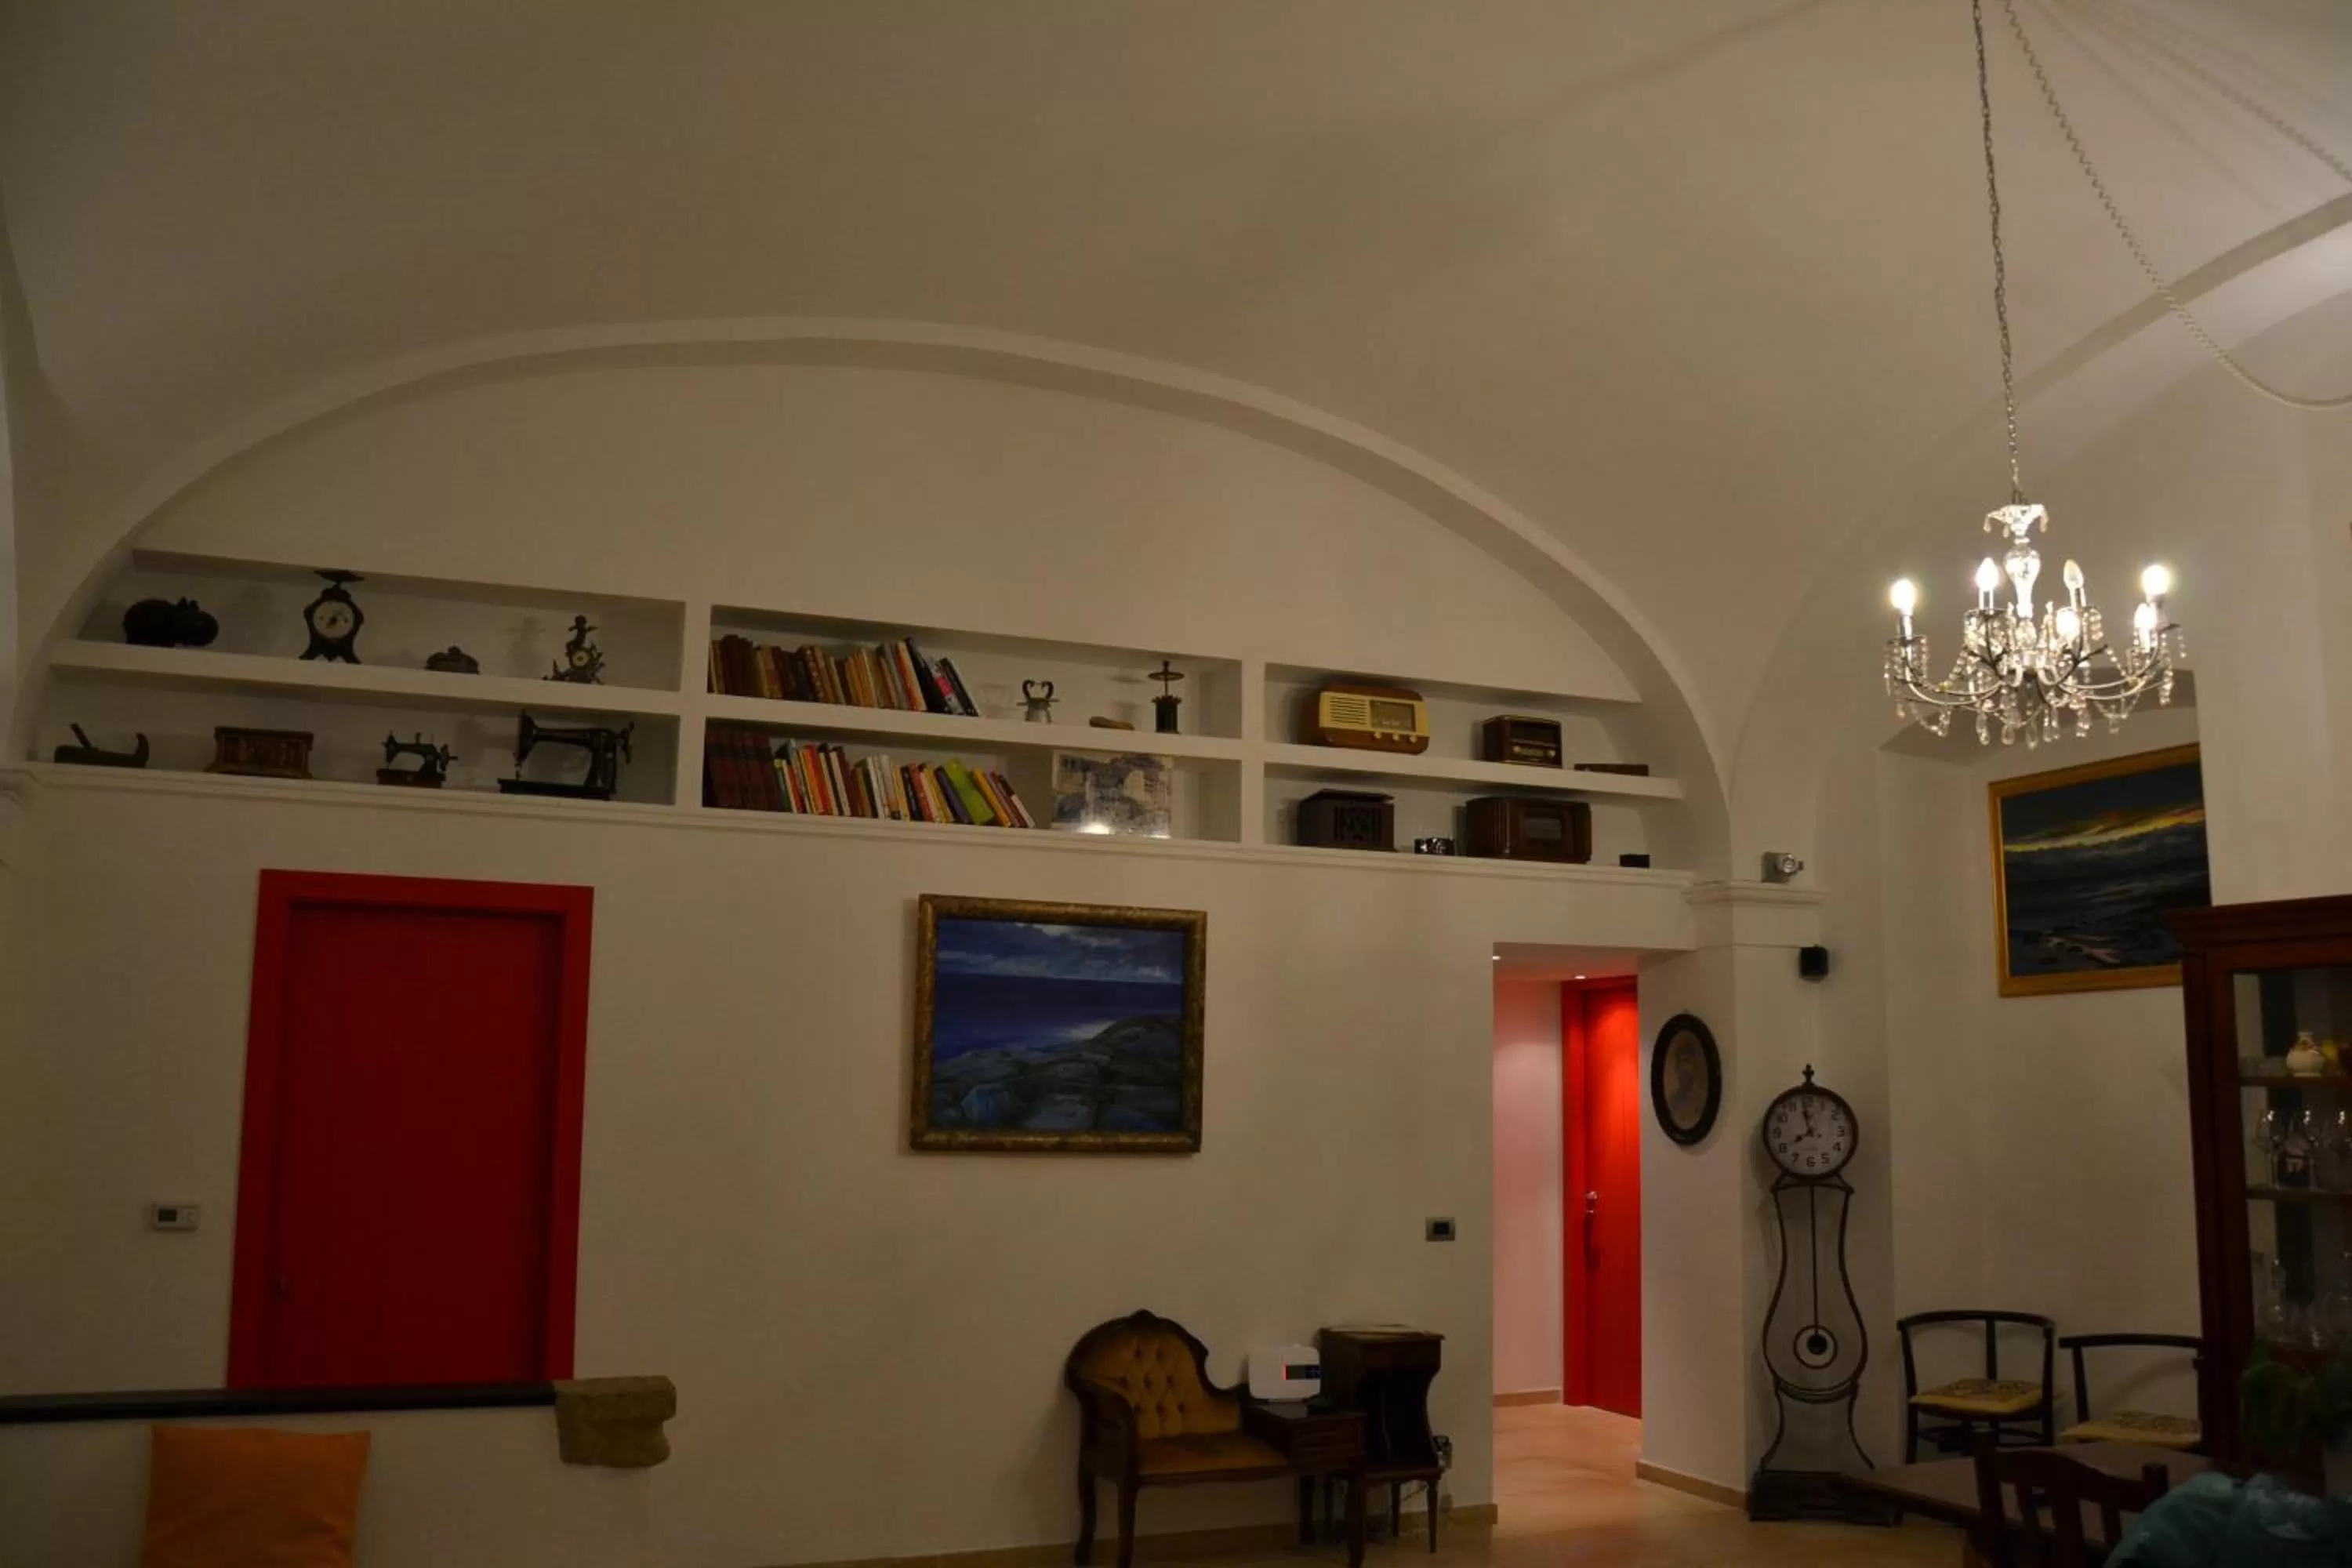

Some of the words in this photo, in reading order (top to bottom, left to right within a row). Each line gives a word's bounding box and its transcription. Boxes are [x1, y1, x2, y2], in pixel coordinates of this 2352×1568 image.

[1831, 1109, 1838, 1120] 2
[1838, 1125, 1846, 1137] 3
[1780, 1143, 1788, 1152] 8
[1833, 1142, 1841, 1152] 4
[1791, 1152, 1799, 1163] 7
[1806, 1156, 1816, 1167] 6
[1821, 1152, 1830, 1164] 5
